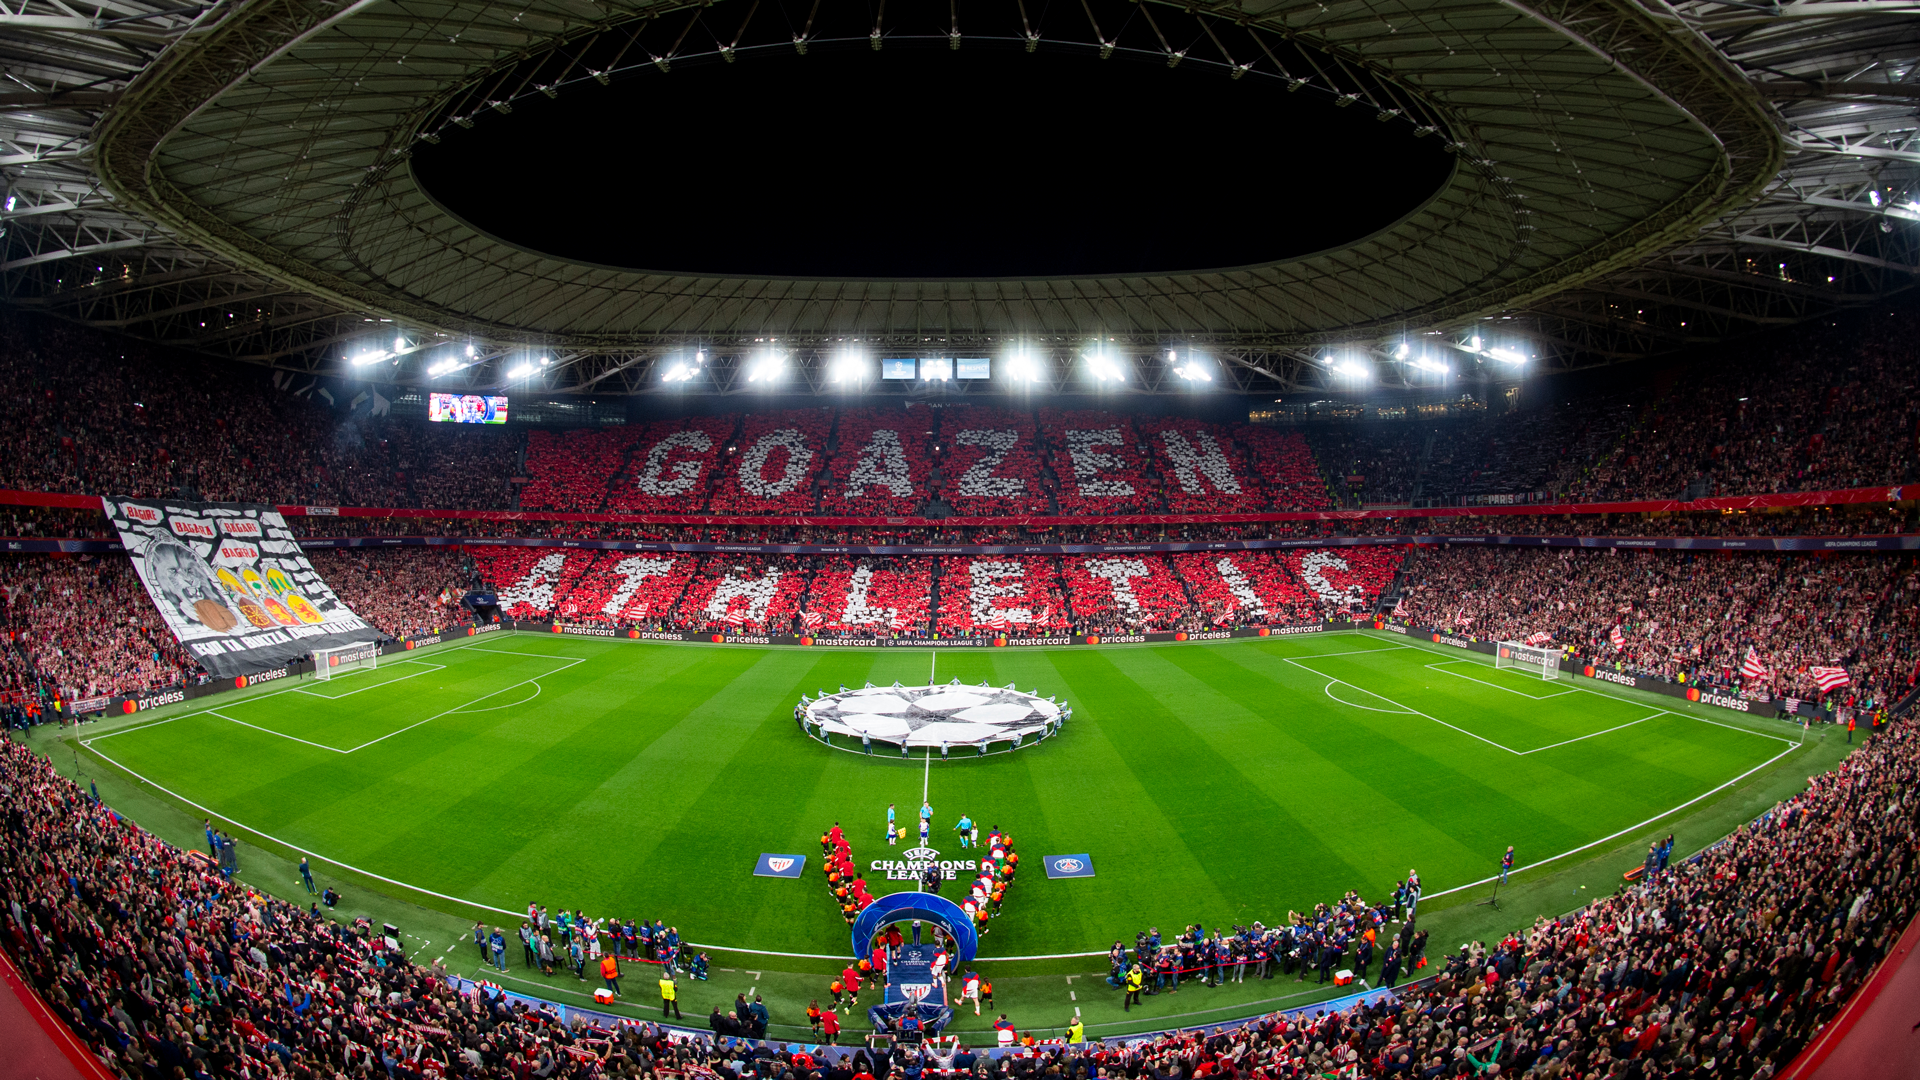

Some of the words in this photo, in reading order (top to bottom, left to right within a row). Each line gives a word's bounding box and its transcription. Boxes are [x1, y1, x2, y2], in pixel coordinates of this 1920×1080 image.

[637, 428, 1242, 498] GOAZEN
[1488, 494, 1514, 504] PARIS
[126, 506, 157, 521] BAGIRE
[174, 522, 214, 536] BAGARA
[224, 522, 258, 533] BAGARE
[497, 550, 1363, 627] ATHLETIC
[475, 623, 501, 634] priceless
[564, 626, 615, 636] mastercard
[1272, 624, 1323, 635] mastercard
[1385, 624, 1406, 634] priceless
[220, 639, 246, 652] TA
[320, 619, 369, 634] BATERA
[642, 631, 682, 640] priceless
[726, 635, 769, 644] priceless
[1101, 635, 1145, 644] priceless
[1190, 631, 1230, 641] priceless
[415, 636, 441, 648] priceless
[816, 638, 877, 647] mastercard
[1009, 637, 1070, 646] mastercard
[1440, 636, 1468, 648] priceless
[340, 646, 382, 663] mastercard
[1510, 651, 1555, 667] mastercard
[248, 668, 287, 686] priceless
[1596, 670, 1636, 686] priceless
[139, 691, 184, 710] priceless
[1701, 692, 1749, 712] priceless
[904, 849, 936, 859] UEFA
[886, 870, 956, 880] LEAE
